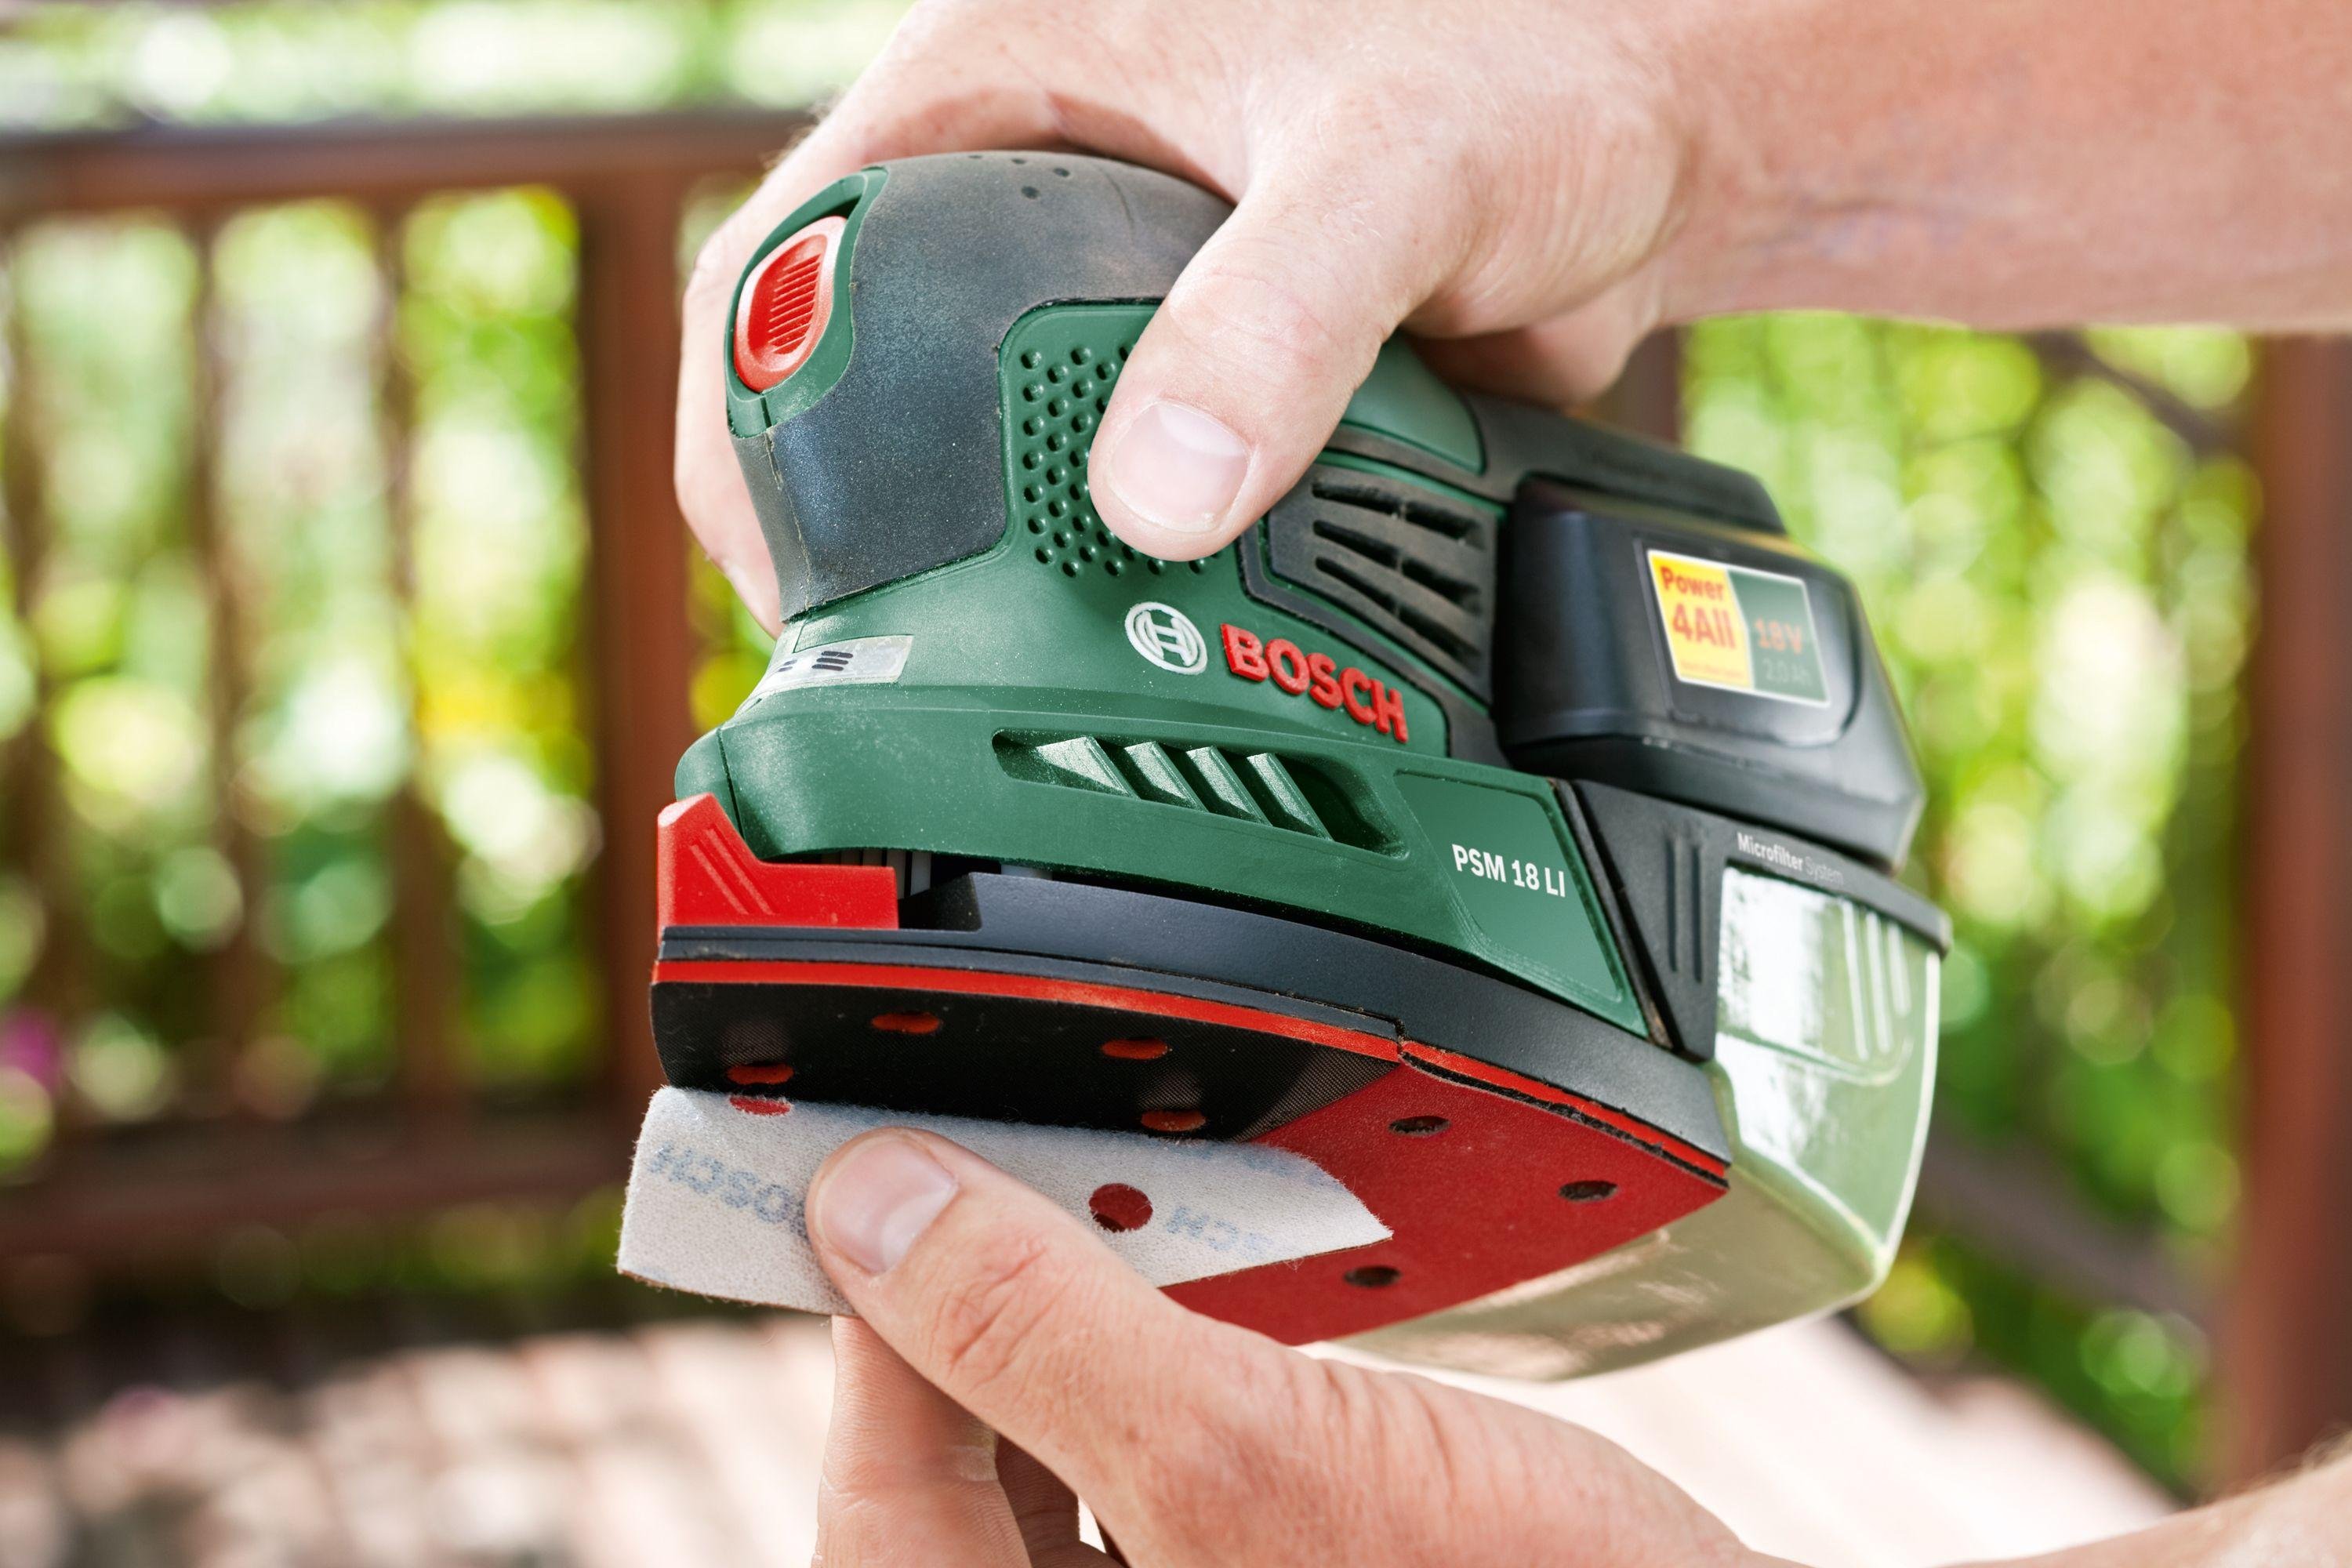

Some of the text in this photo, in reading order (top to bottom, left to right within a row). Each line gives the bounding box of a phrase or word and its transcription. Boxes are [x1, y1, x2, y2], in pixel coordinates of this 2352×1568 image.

[1661, 566, 1724, 601] Power
[1673, 603, 1736, 649] 4All
[1221, 622, 1409, 744] BOSCH
[1452, 844, 1565, 898] PSM 18 LI
[1737, 832, 1843, 884] Microfilter System
